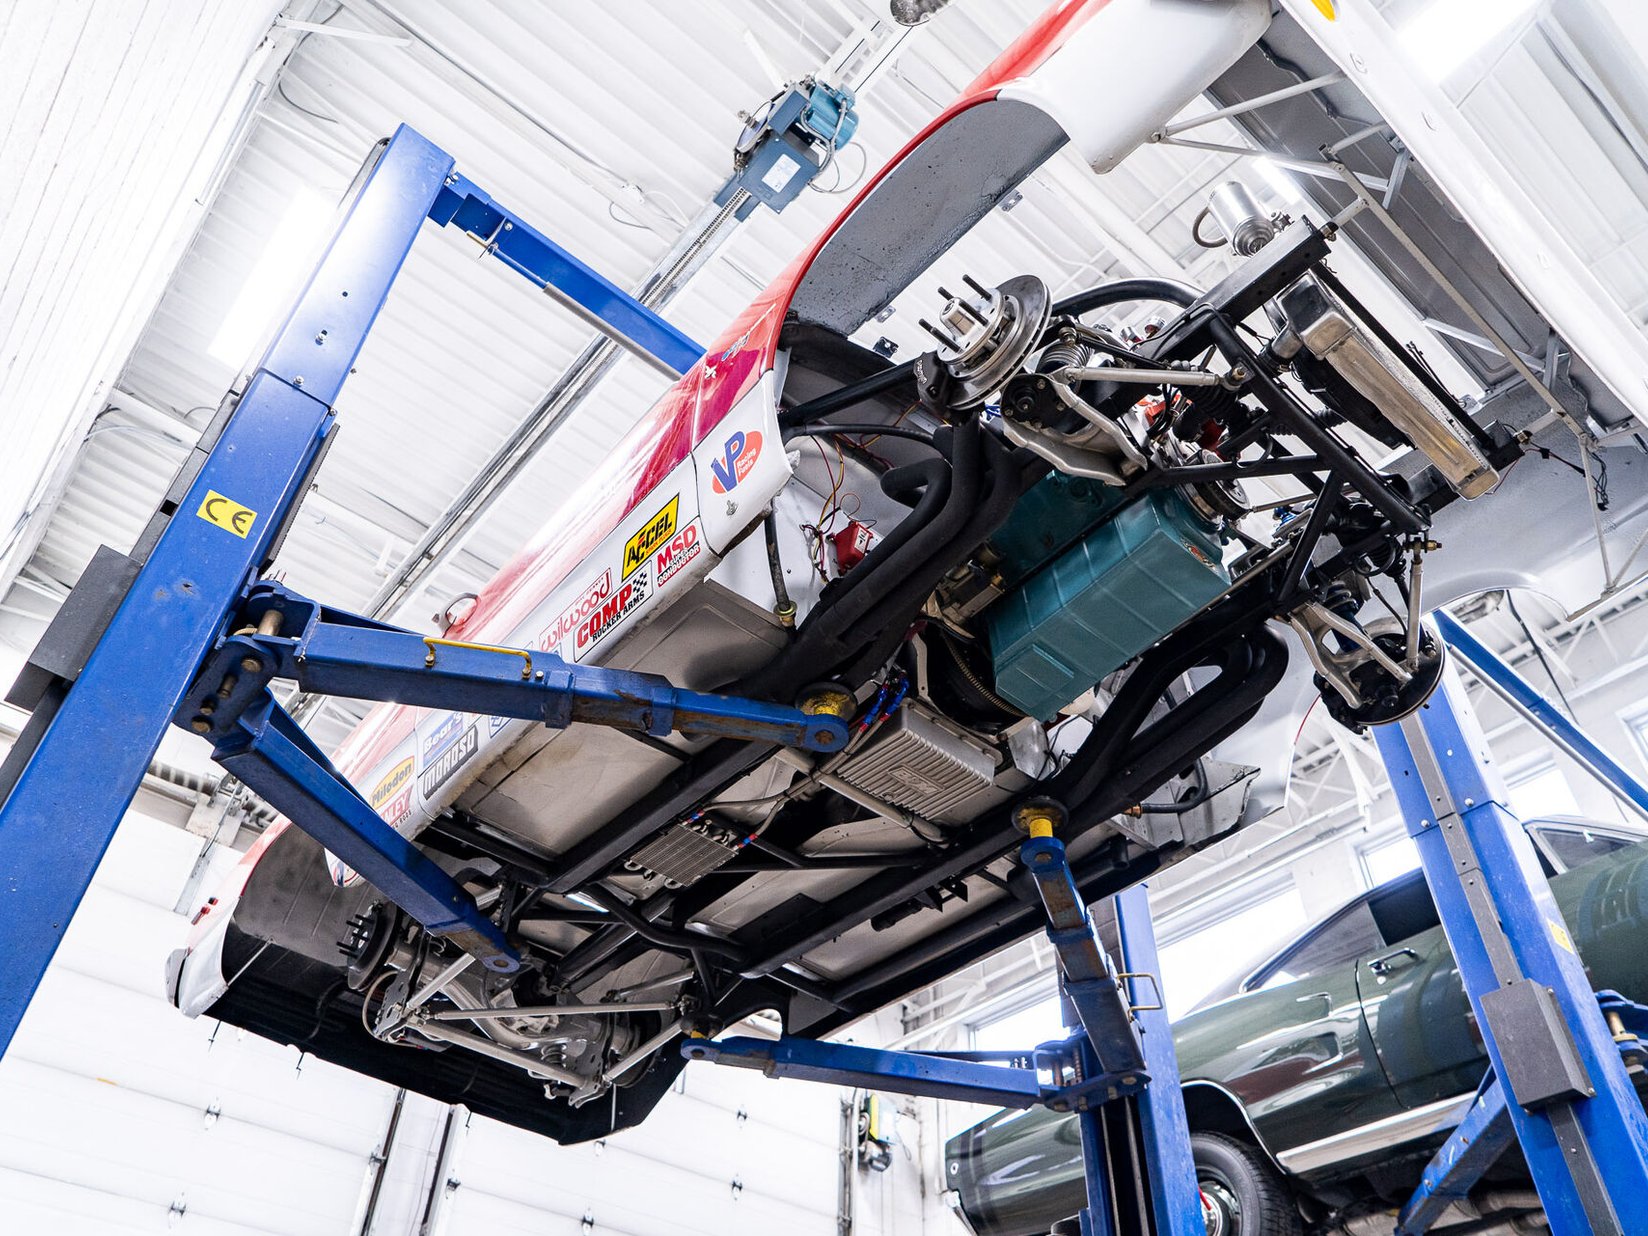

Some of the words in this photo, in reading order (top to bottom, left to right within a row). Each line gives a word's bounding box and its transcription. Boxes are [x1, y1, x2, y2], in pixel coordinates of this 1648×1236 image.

[711, 431, 745, 492] VP
[736, 448, 757, 468] Racing
[206, 498, 253, 535] CE
[627, 512, 672, 567] ACCEL
[657, 524, 697, 574] MSD
[657, 543, 700, 586] CONDUCTOR
[541, 572, 609, 651] wilwood
[577, 583, 632, 648] COMP
[592, 611, 622, 642] ROCKER
[622, 590, 645, 615] ARMS
[372, 763, 411, 807] Milodon
[423, 725, 478, 800] MOROSO
